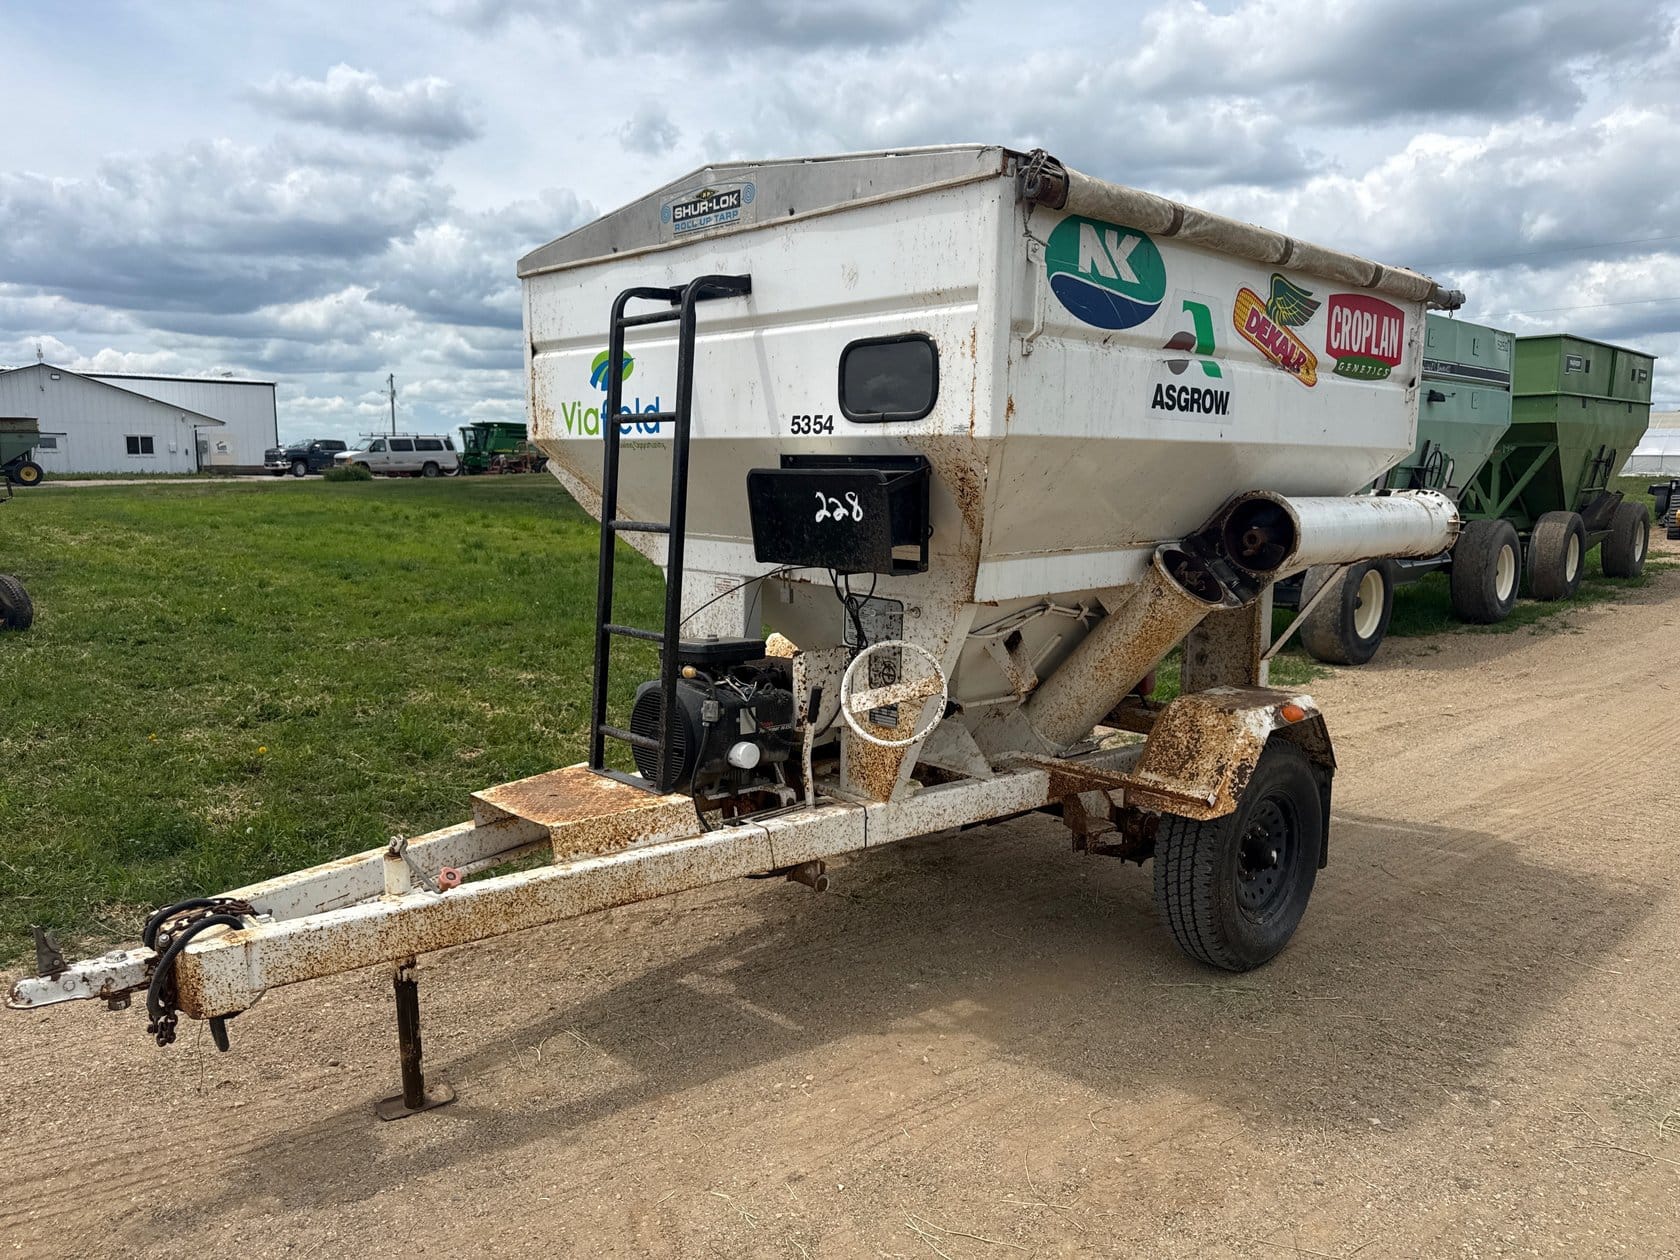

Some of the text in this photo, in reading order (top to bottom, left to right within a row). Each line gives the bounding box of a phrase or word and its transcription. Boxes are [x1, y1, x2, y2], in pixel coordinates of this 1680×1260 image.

[674, 192, 739, 219] SHUR-LOK
[700, 215, 712, 226] UP
[714, 209, 739, 222] TARP
[1078, 222, 1143, 284] NK
[1244, 305, 1307, 373] DEKALB
[1330, 304, 1400, 359] CROPLAN
[1338, 361, 1390, 377] GENETICS
[1151, 383, 1230, 415] ASGROW
[561, 396, 660, 440] Viafeld
[790, 414, 834, 435] 5354
[815, 491, 864, 523] 228
